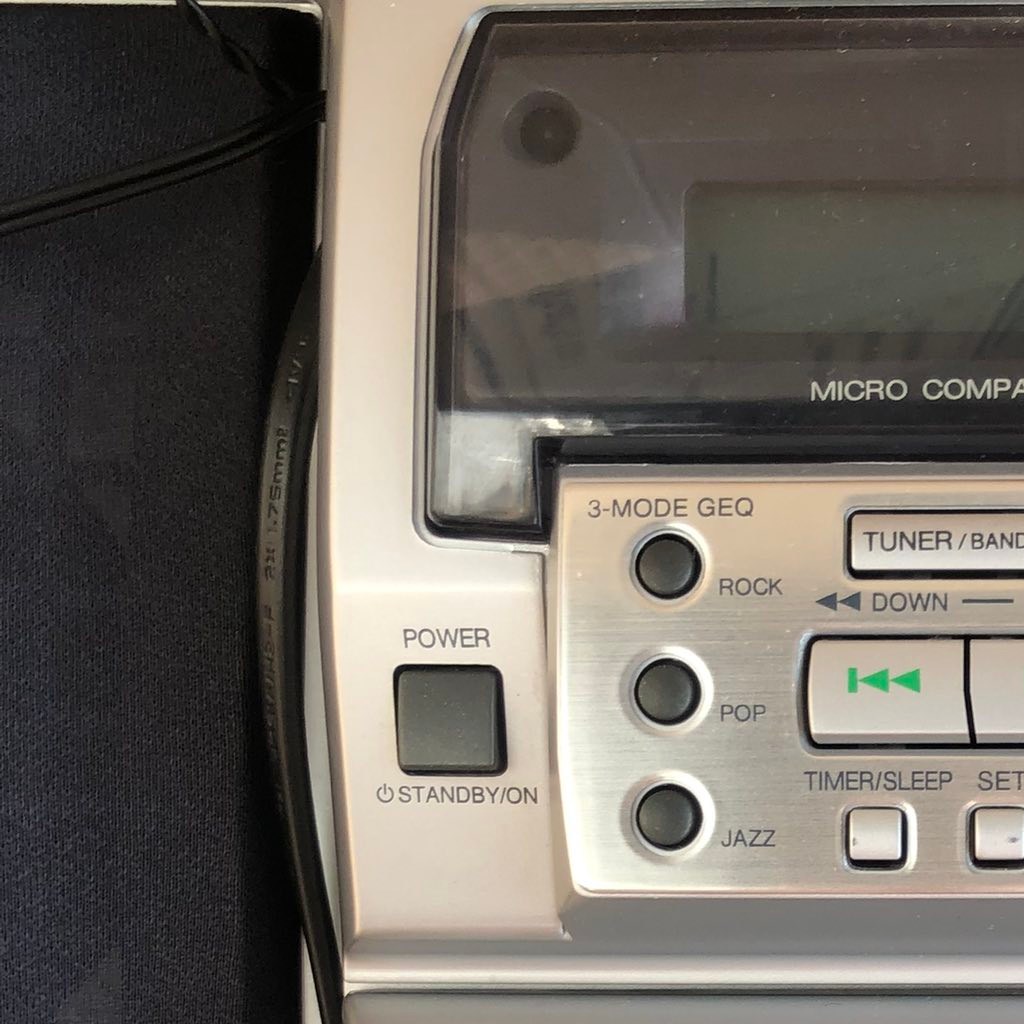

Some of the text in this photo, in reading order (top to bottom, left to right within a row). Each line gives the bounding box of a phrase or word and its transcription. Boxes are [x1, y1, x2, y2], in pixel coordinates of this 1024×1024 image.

[810, 379, 908, 402] MICRO
[588, 497, 754, 519] 3-MODE GEQ
[719, 577, 783, 597] ROCK
[872, 592, 948, 613] DOWN
[402, 627, 491, 649] POWER
[720, 704, 766, 723] POP
[803, 770, 953, 791] TIMER/SLEEP
[398, 785, 538, 805] STANDBY/ON
[721, 829, 776, 848] JAZZ
